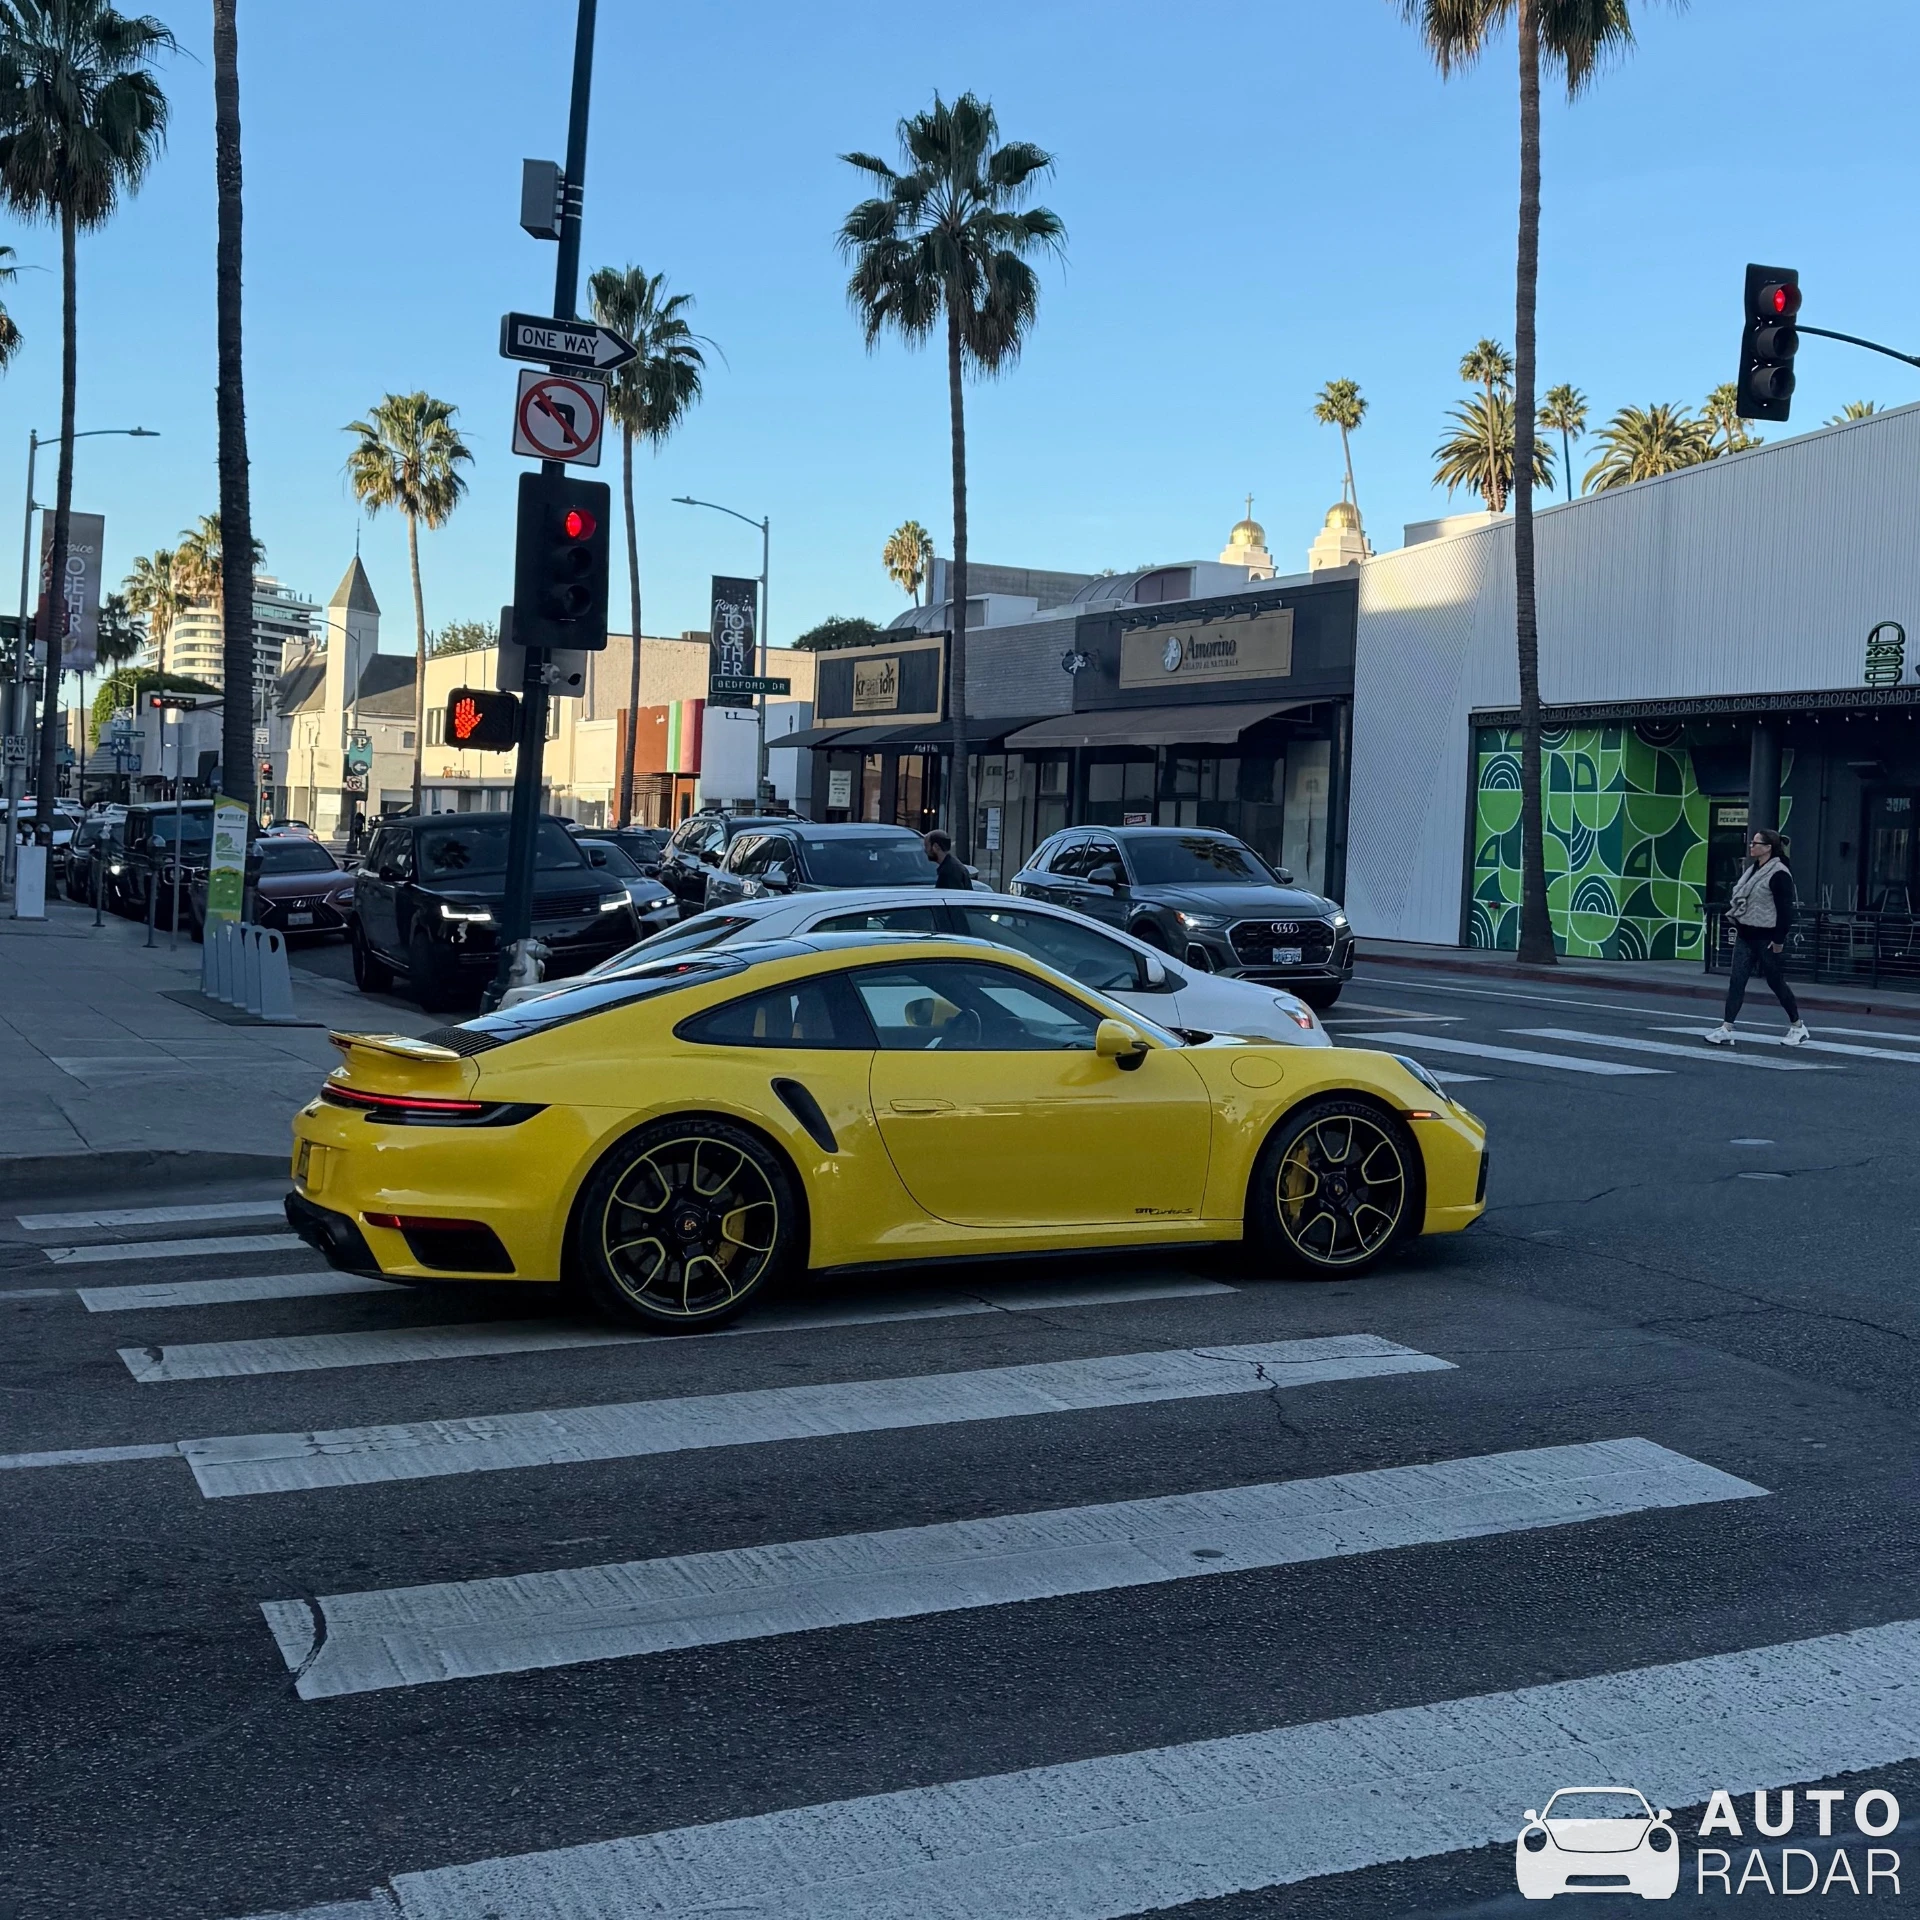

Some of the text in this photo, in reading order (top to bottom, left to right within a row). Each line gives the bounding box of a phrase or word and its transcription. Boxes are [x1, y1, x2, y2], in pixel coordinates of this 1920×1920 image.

[522, 328, 599, 355] ONE WAY
[715, 598, 755, 614] Ring in
[721, 613, 745, 630] TO
[720, 629, 744, 646] GE
[721, 645, 744, 662] TH
[1184, 634, 1237, 660] Amorino
[720, 660, 743, 676] ER
[717, 680, 786, 691] BEDFORD DR
[1590, 702, 1621, 718] SHAKES
[1623, 704, 1640, 717] HOT
[1642, 702, 1667, 715] DOGS
[1668, 700, 1701, 713] FLOATS
[1705, 698, 1730, 712] SODA
[1733, 696, 1767, 710] CONES
[1769, 693, 1815, 709] BURGERS
[1817, 691, 1860, 707] FROZEN
[1861, 688, 1911, 706] CUSTARD
[7, 746, 26, 754] WAY
[8, 738, 26, 746] ONE
[357, 737, 367, 748] P
